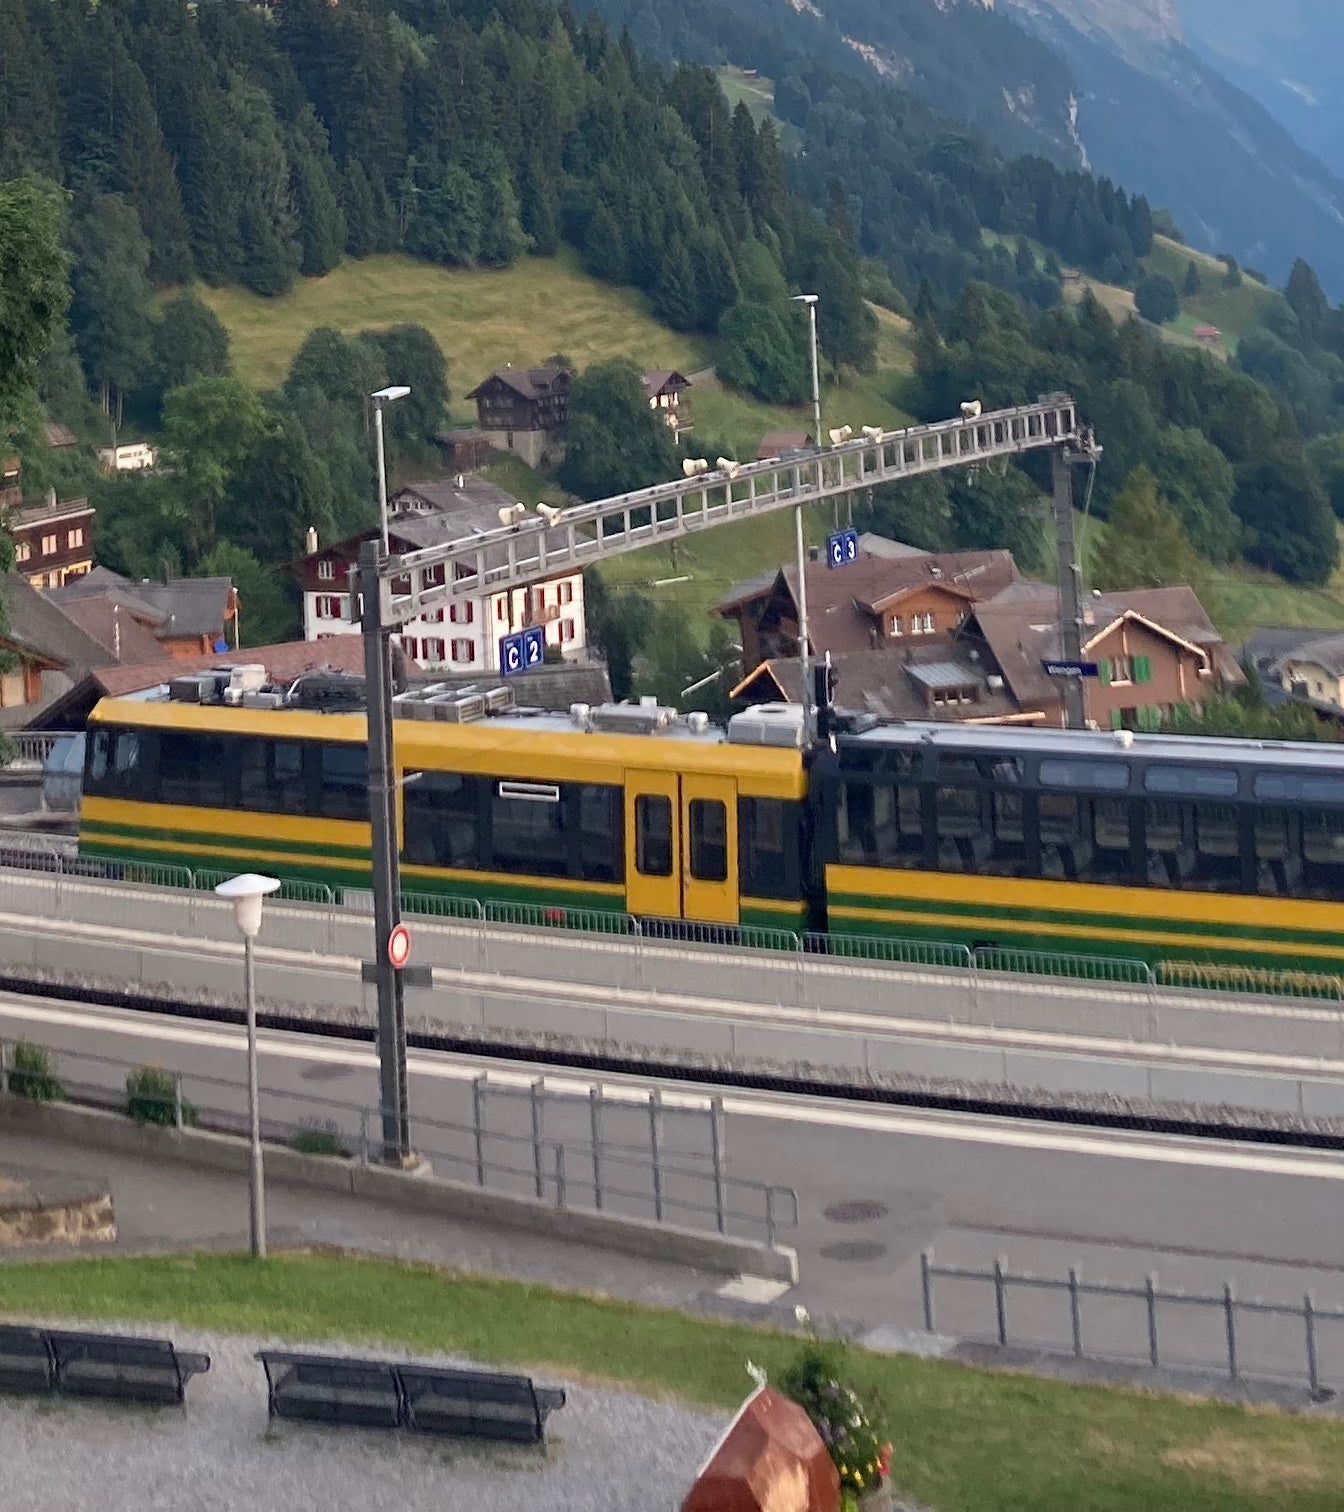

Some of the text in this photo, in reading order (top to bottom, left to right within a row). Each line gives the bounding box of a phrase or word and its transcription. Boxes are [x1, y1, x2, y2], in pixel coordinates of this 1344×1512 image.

[833, 540, 855, 563] C 3
[508, 640, 539, 669] C 2
